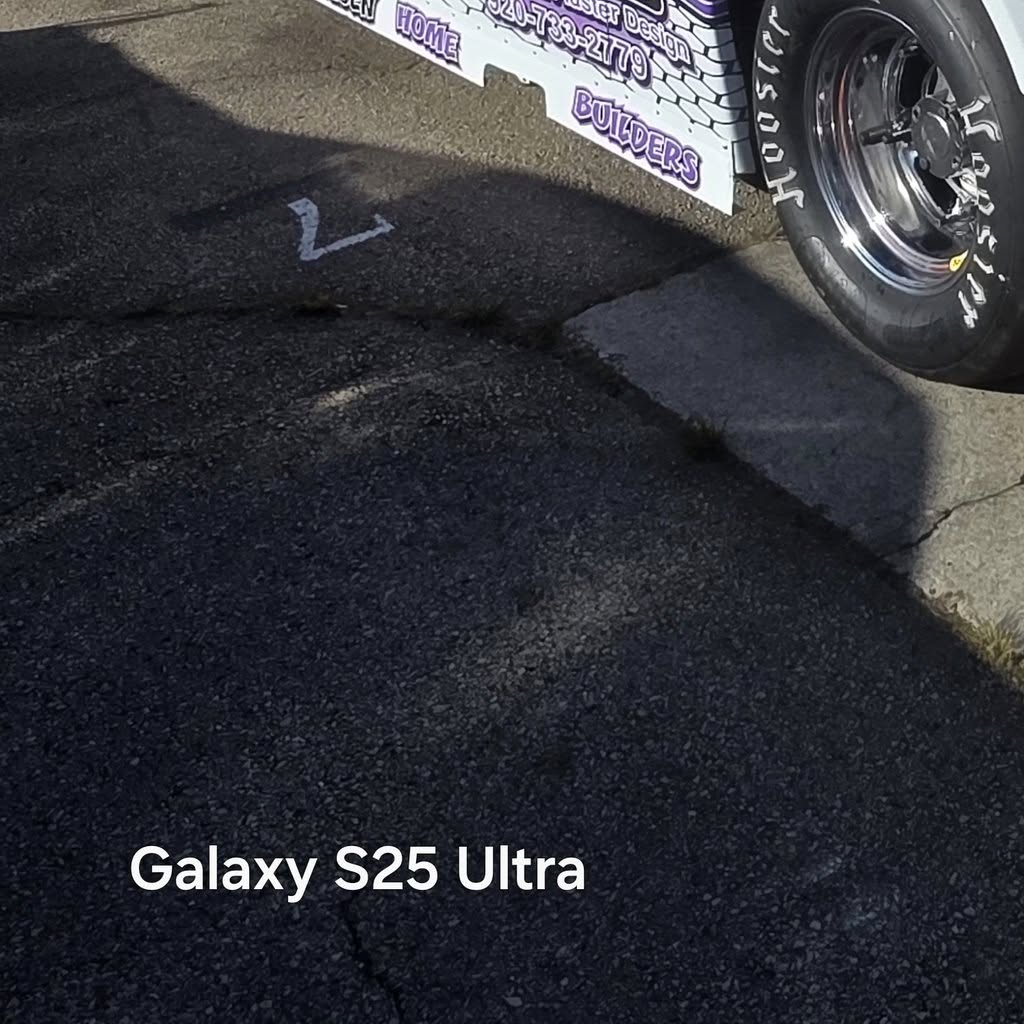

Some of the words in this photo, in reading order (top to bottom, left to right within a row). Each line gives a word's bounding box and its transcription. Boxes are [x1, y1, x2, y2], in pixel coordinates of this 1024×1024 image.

[395, 1, 461, 64] HOME
[623, 6, 693, 64] Design
[573, 88, 701, 187] BUILDERS
[754, 5, 804, 209] Hoosier
